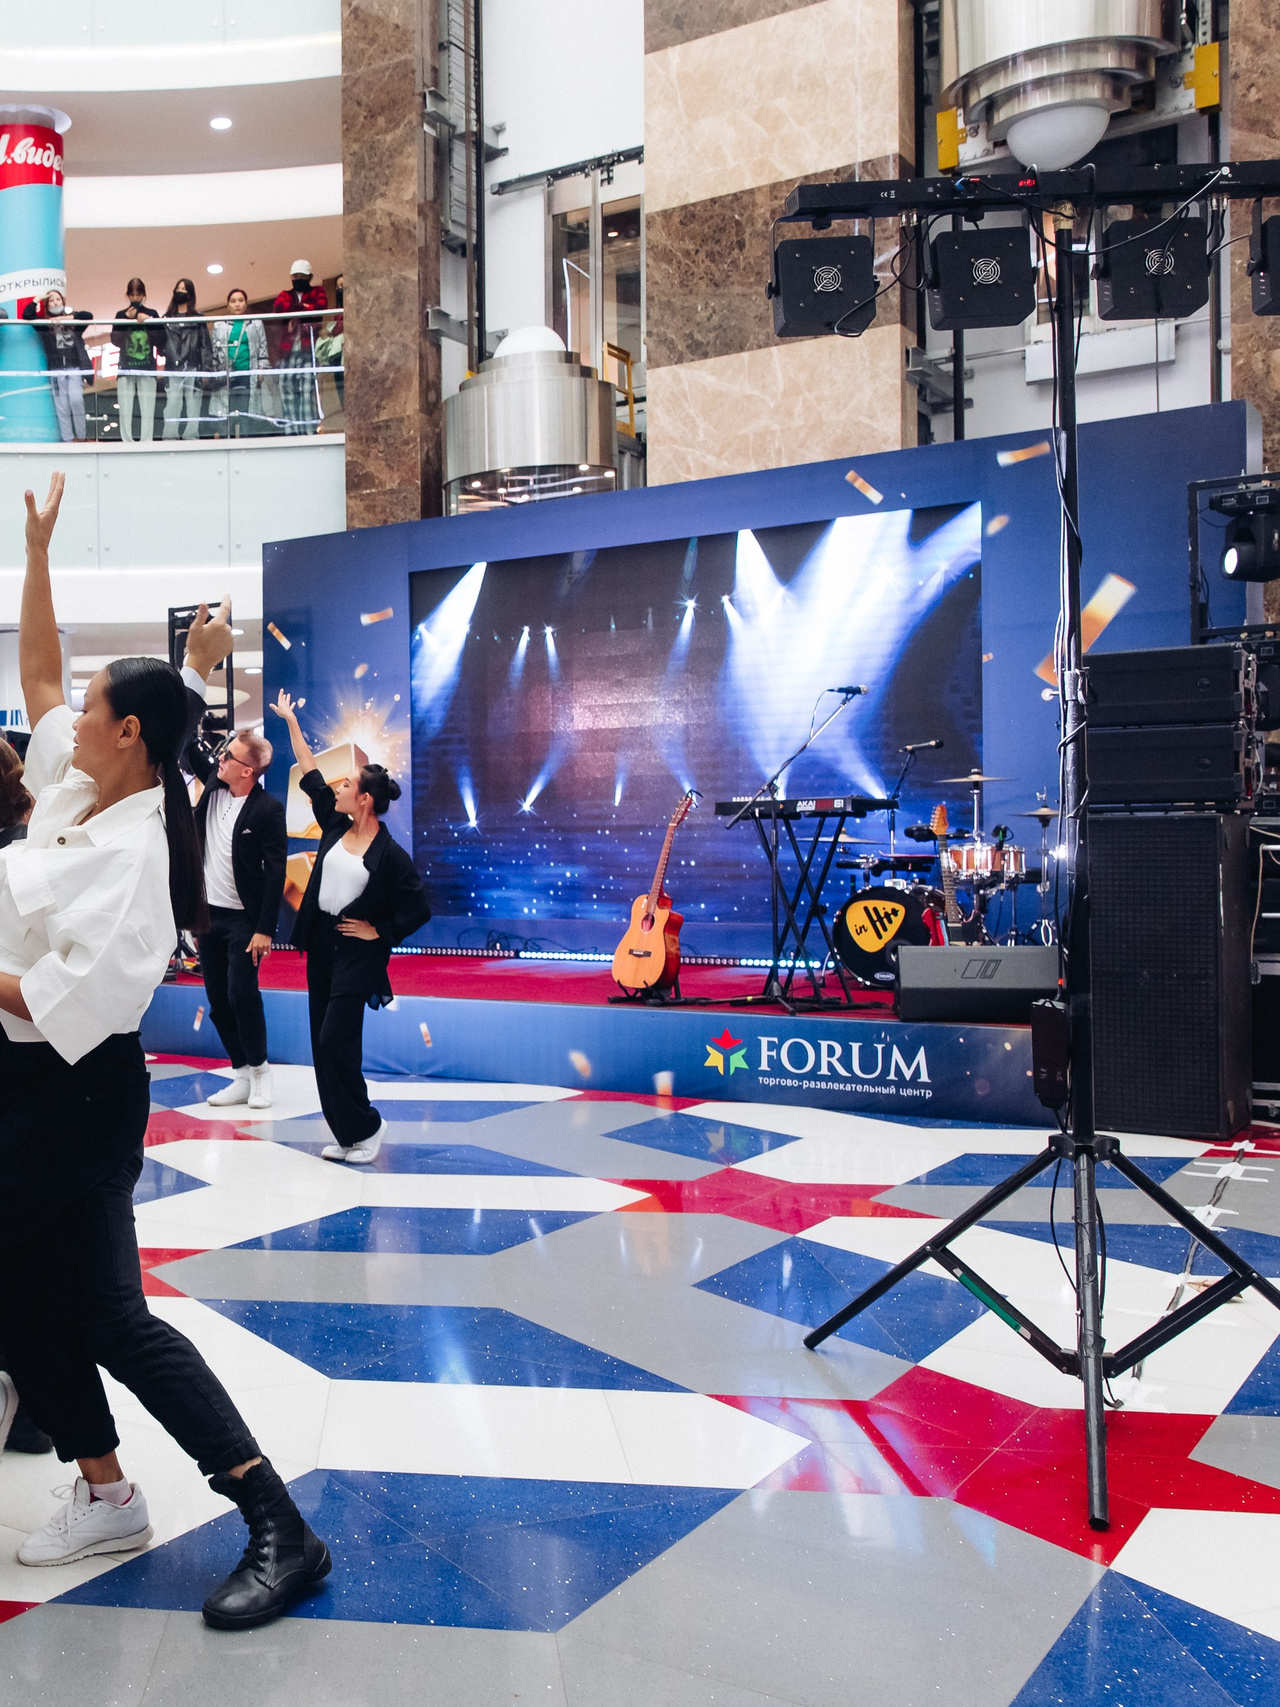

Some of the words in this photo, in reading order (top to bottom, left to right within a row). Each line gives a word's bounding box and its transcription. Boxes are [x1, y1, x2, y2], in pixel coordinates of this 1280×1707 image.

[854, 924, 868, 936] in
[757, 1036, 932, 1082] FORUM
[758, 1076, 896, 1095] торгово-развлекательный
[899, 1087, 933, 1099] центр
